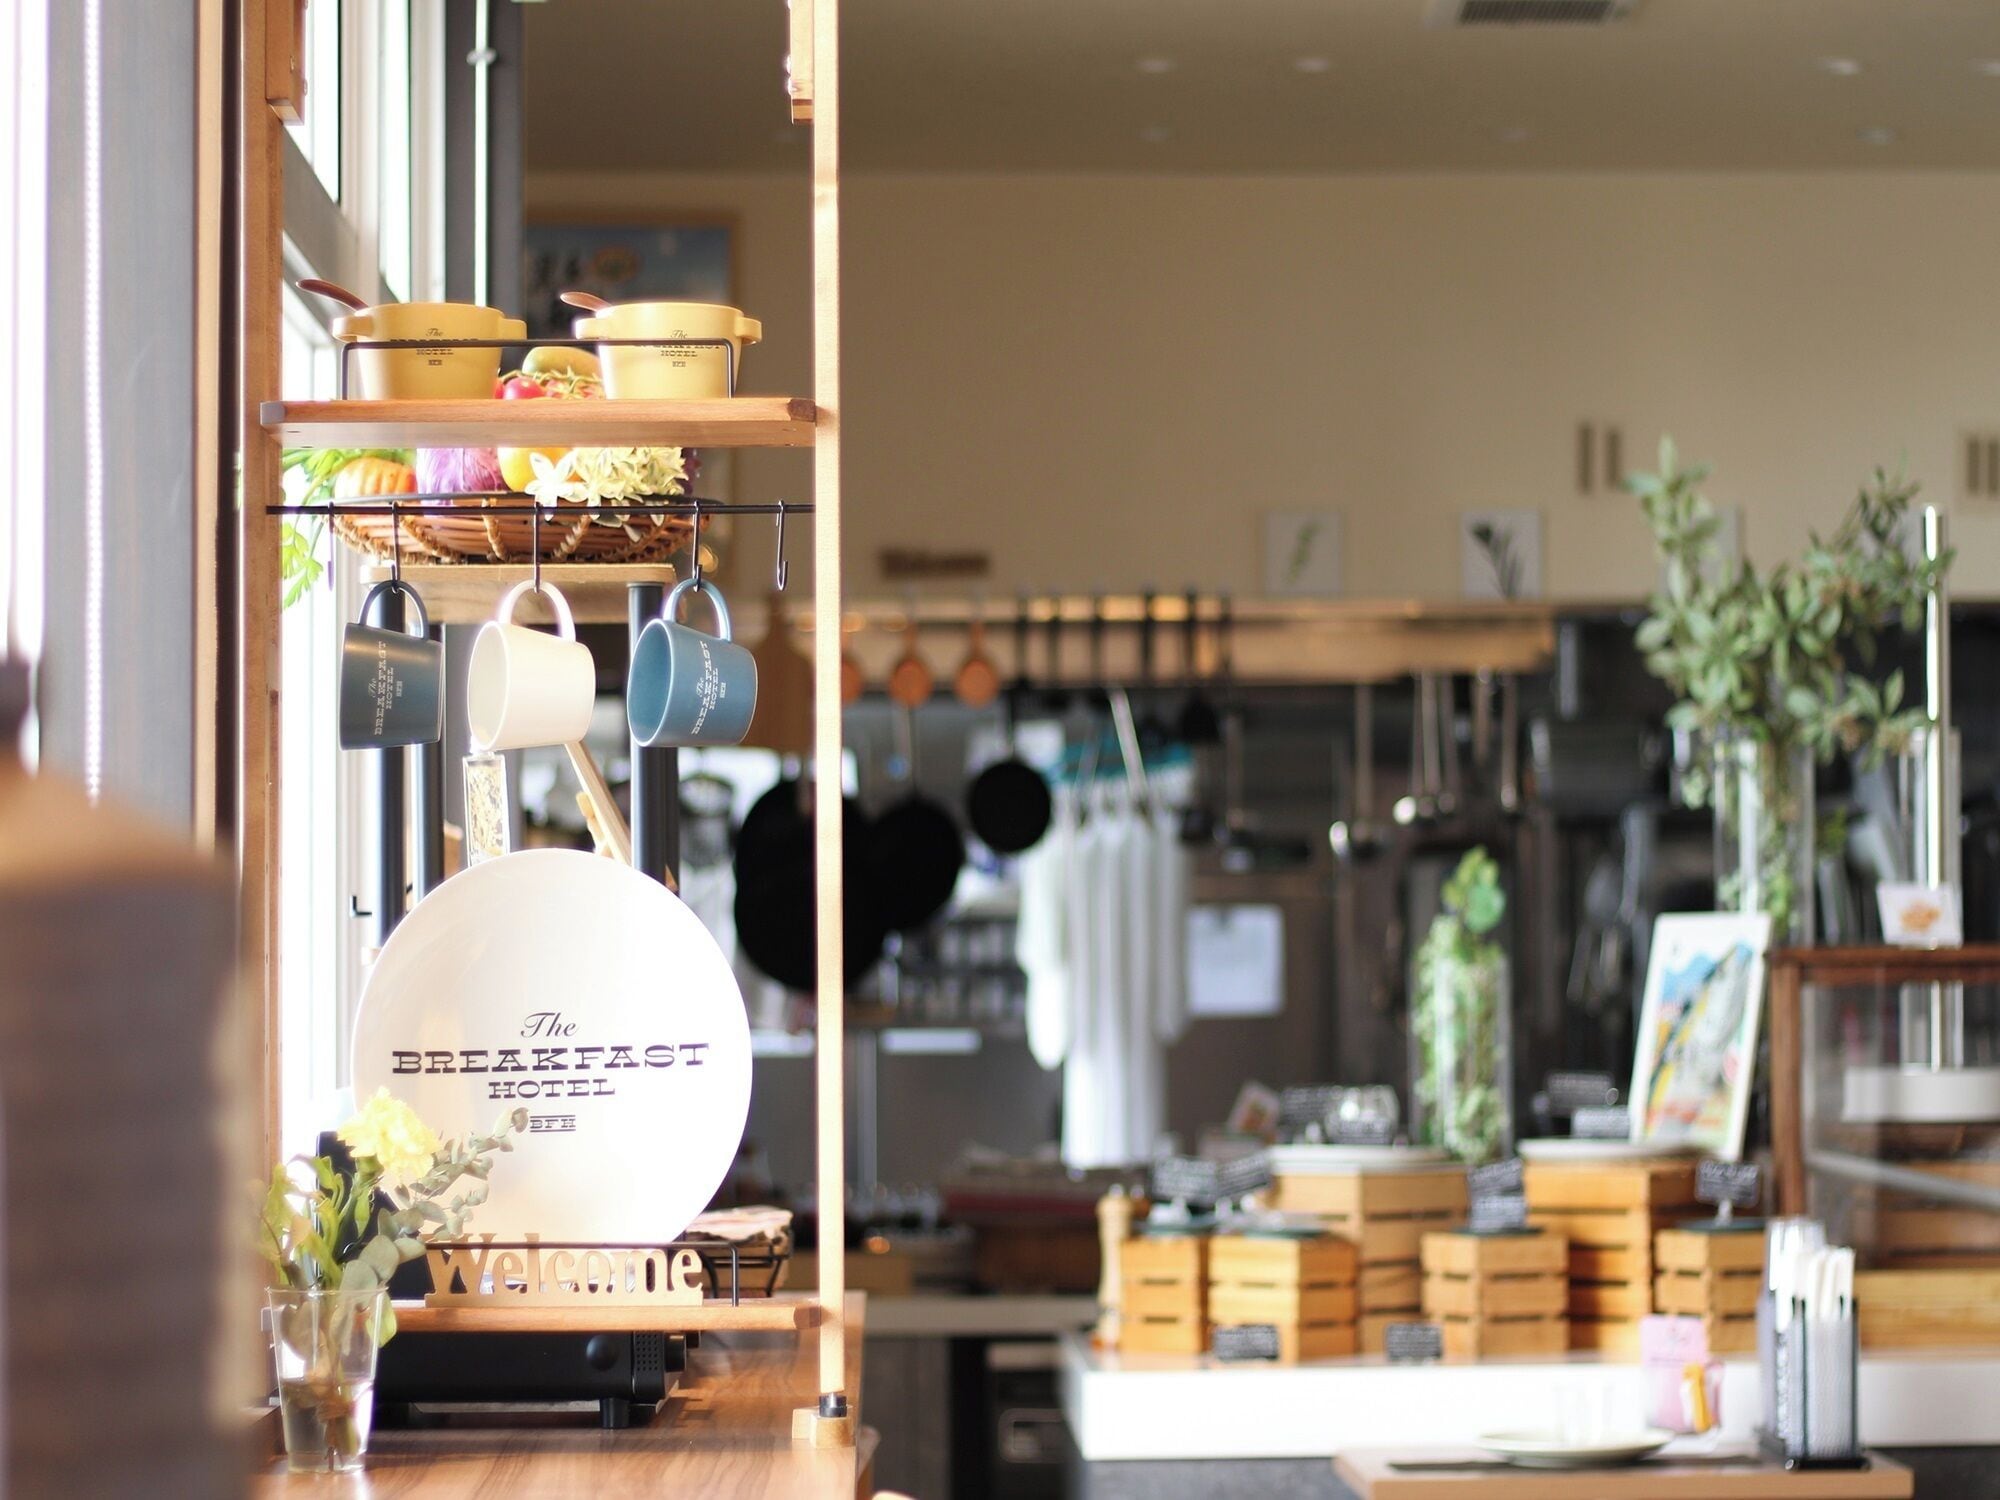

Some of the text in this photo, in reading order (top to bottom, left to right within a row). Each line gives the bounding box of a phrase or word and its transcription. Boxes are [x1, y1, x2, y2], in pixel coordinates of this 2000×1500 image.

[520, 1012, 577, 1038] The
[392, 1043, 709, 1074] BREAKFAST
[488, 1078, 615, 1099] HOTEL
[530, 1117, 576, 1130] BFH
[418, 1233, 703, 1296] Welcome
